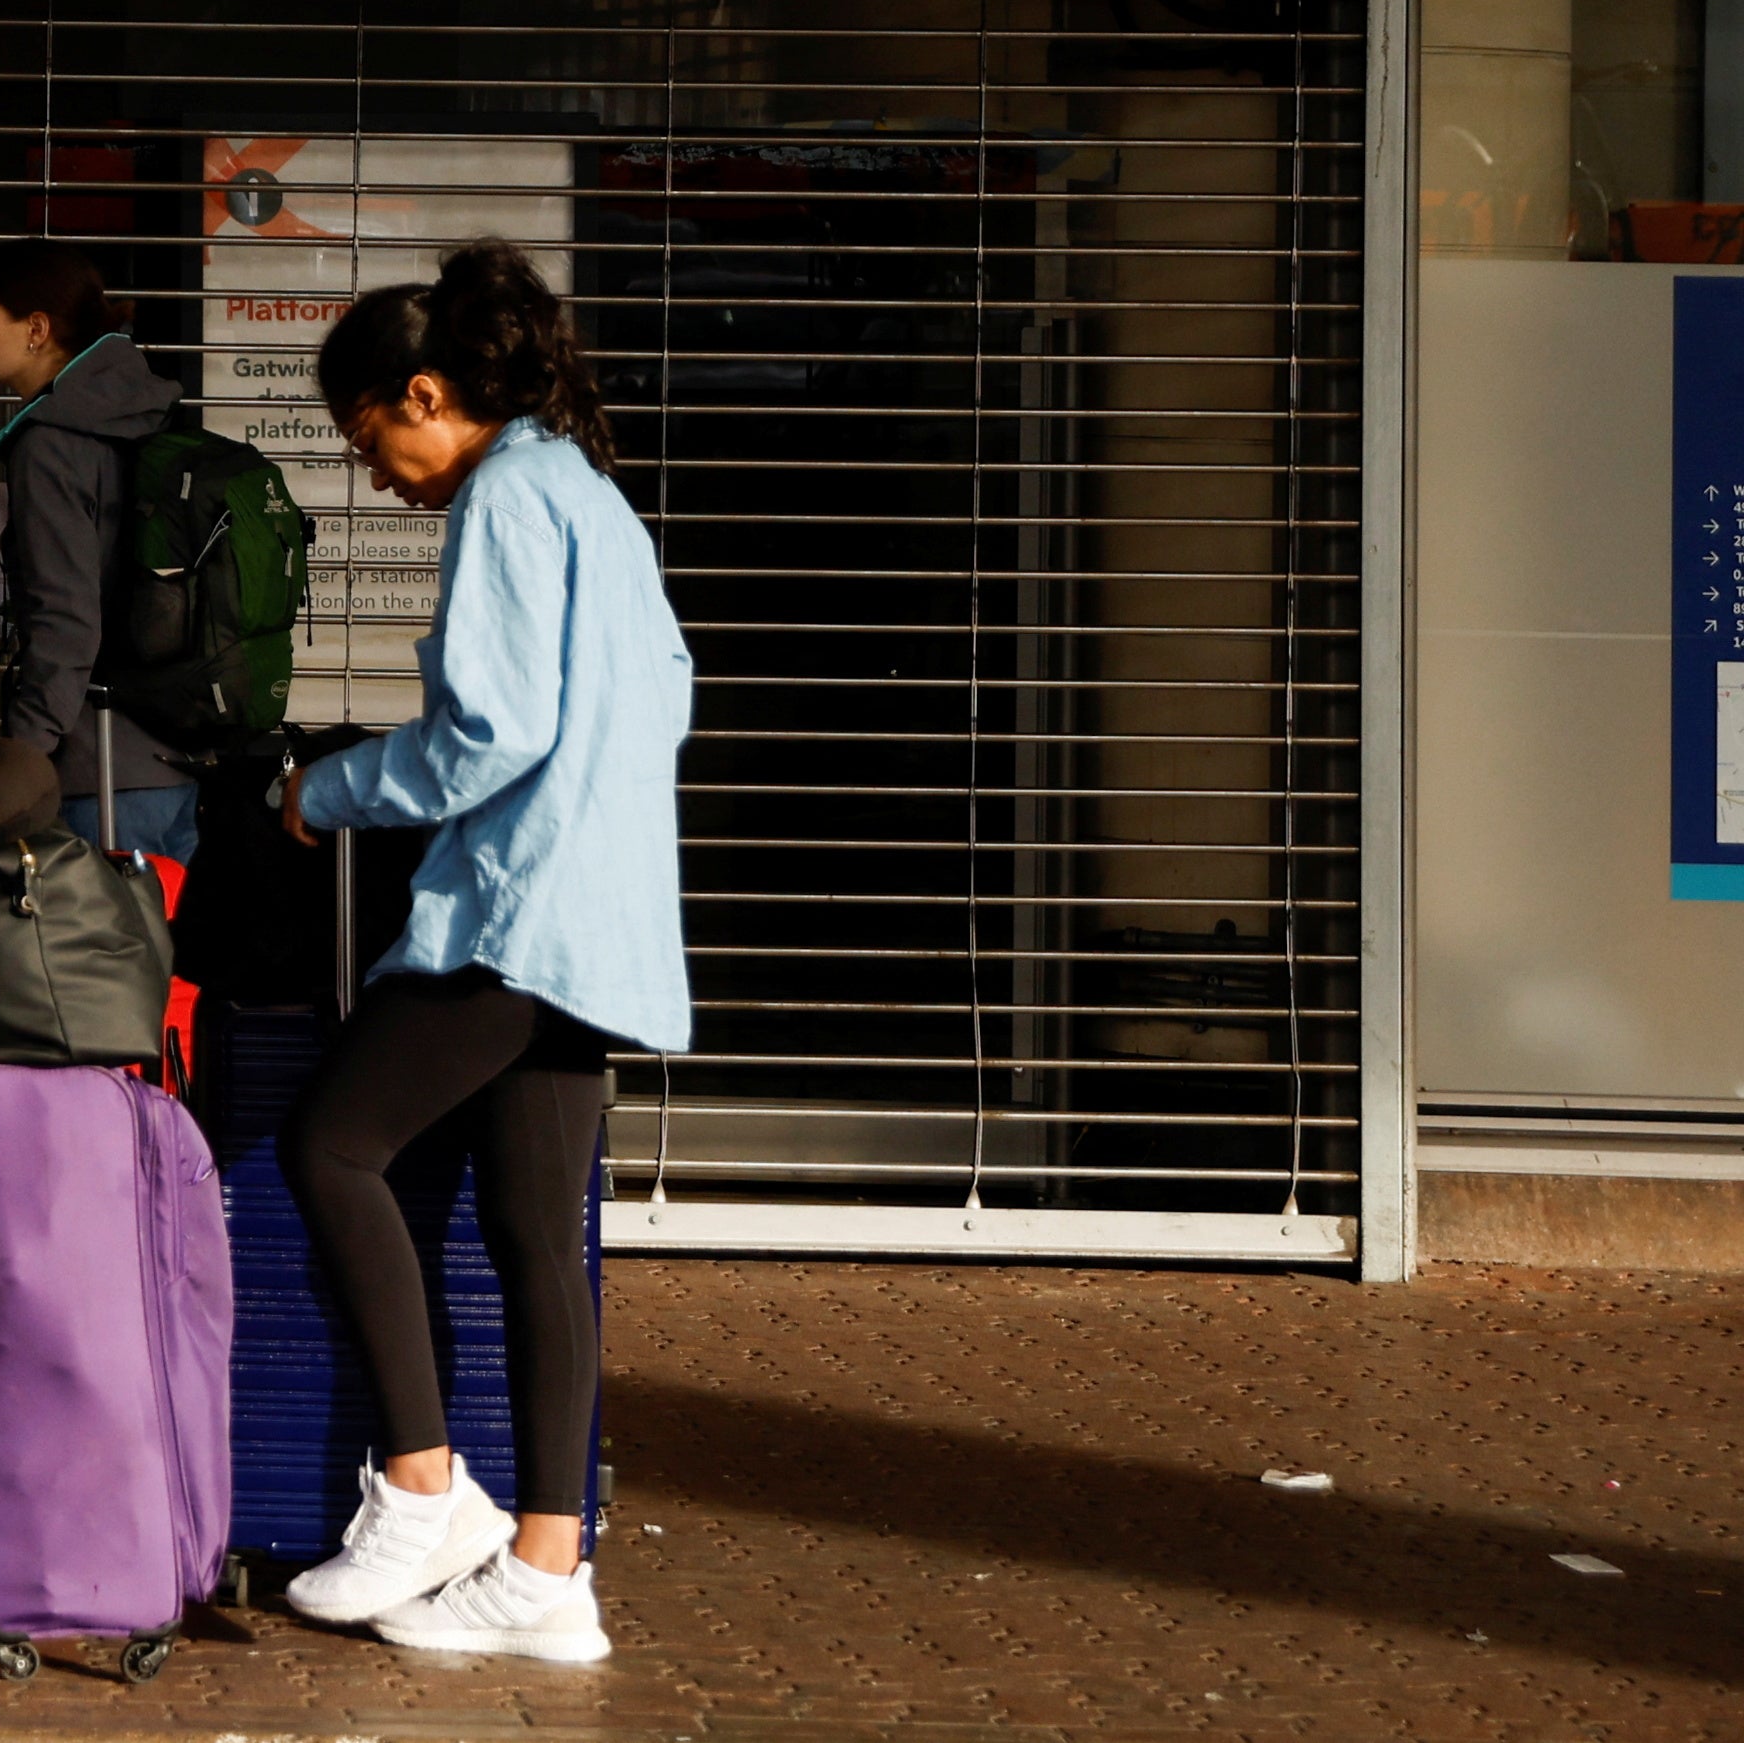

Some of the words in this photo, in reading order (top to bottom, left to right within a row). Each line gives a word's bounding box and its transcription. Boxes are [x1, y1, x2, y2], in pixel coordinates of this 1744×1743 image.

[233, 358, 318, 378] Gatwic
[350, 517, 438, 537] travelling
[307, 540, 341, 557] don
[310, 593, 345, 609] tion
[384, 593, 413, 609] the
